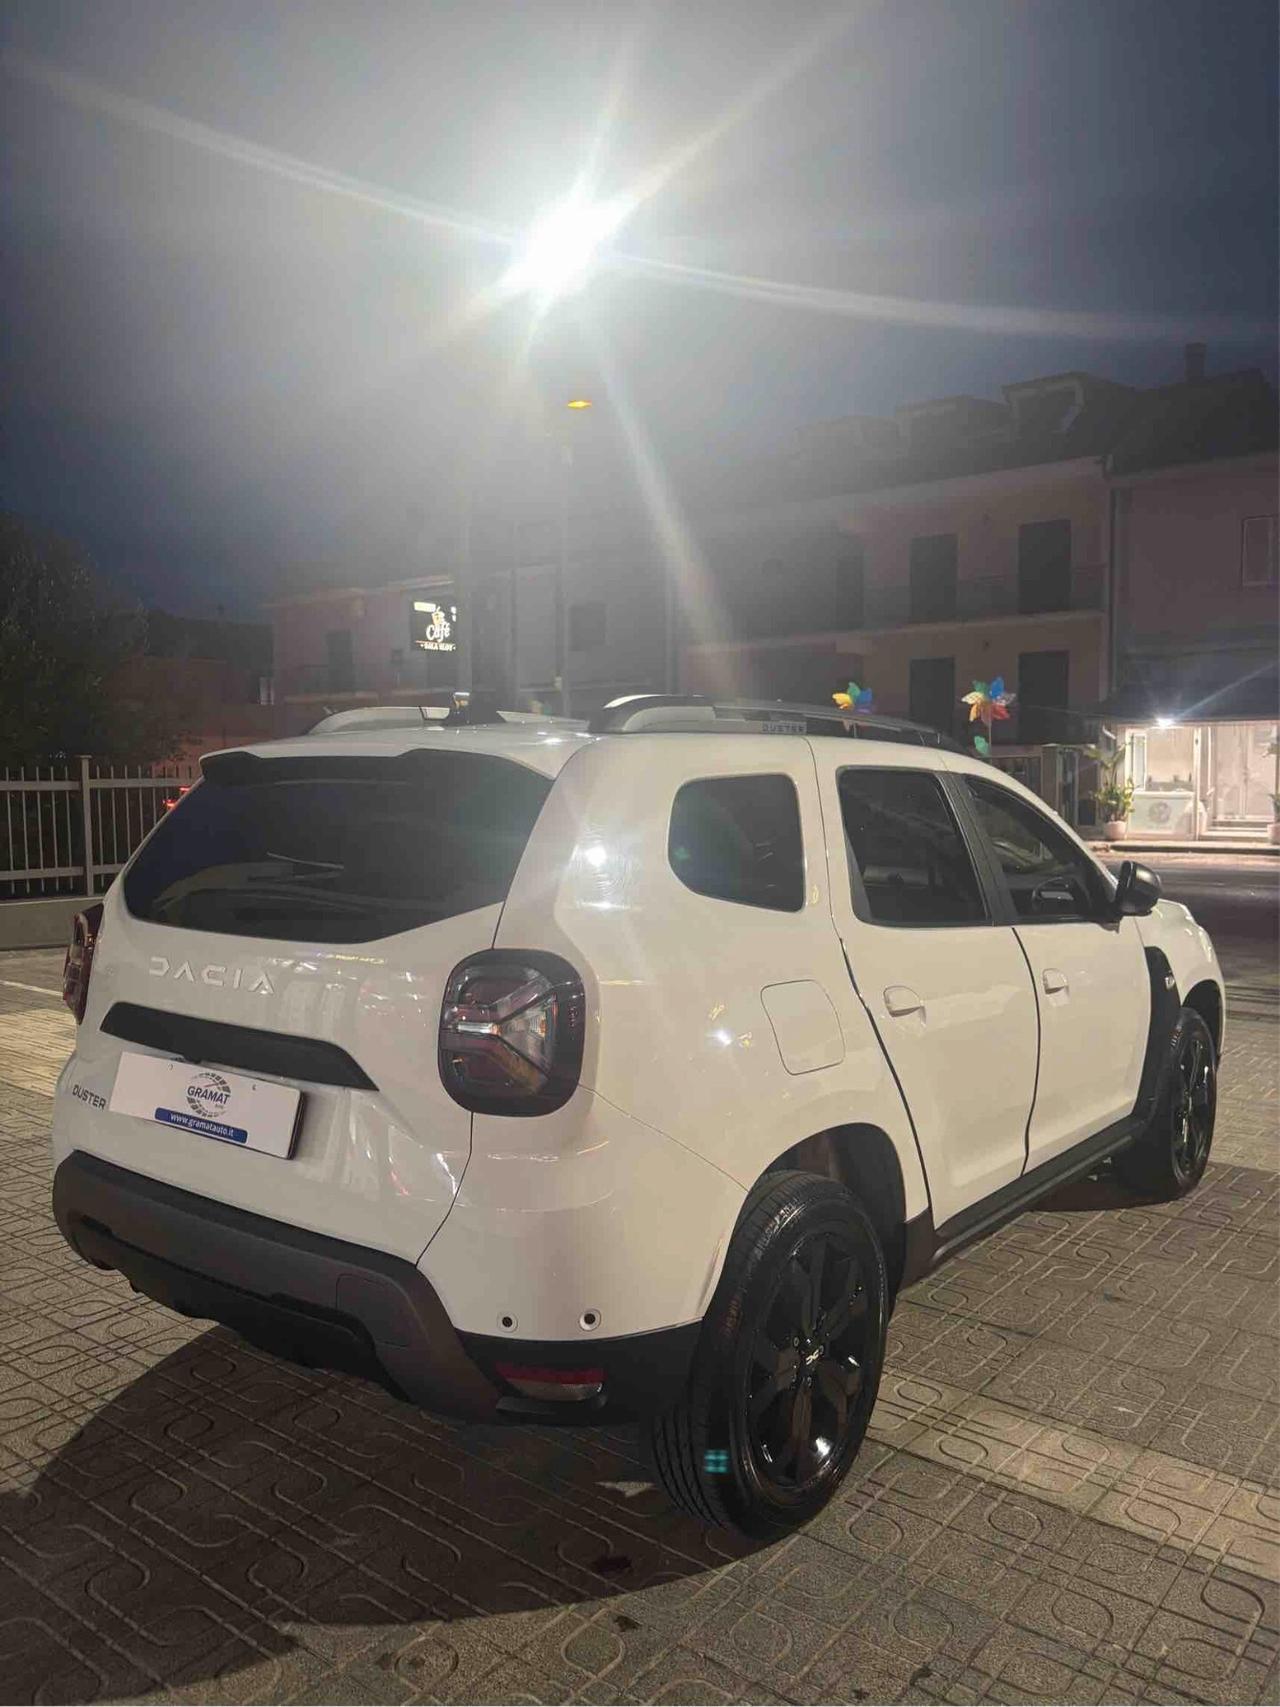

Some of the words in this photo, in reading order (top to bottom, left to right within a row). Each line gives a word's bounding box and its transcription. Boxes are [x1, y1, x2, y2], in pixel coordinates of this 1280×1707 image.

[150, 957, 275, 994] DACIA
[72, 1084, 107, 1110] DUSTER
[187, 1085, 231, 1105] GRAMAT
[170, 1112, 234, 1138] www.gramatauto.it
